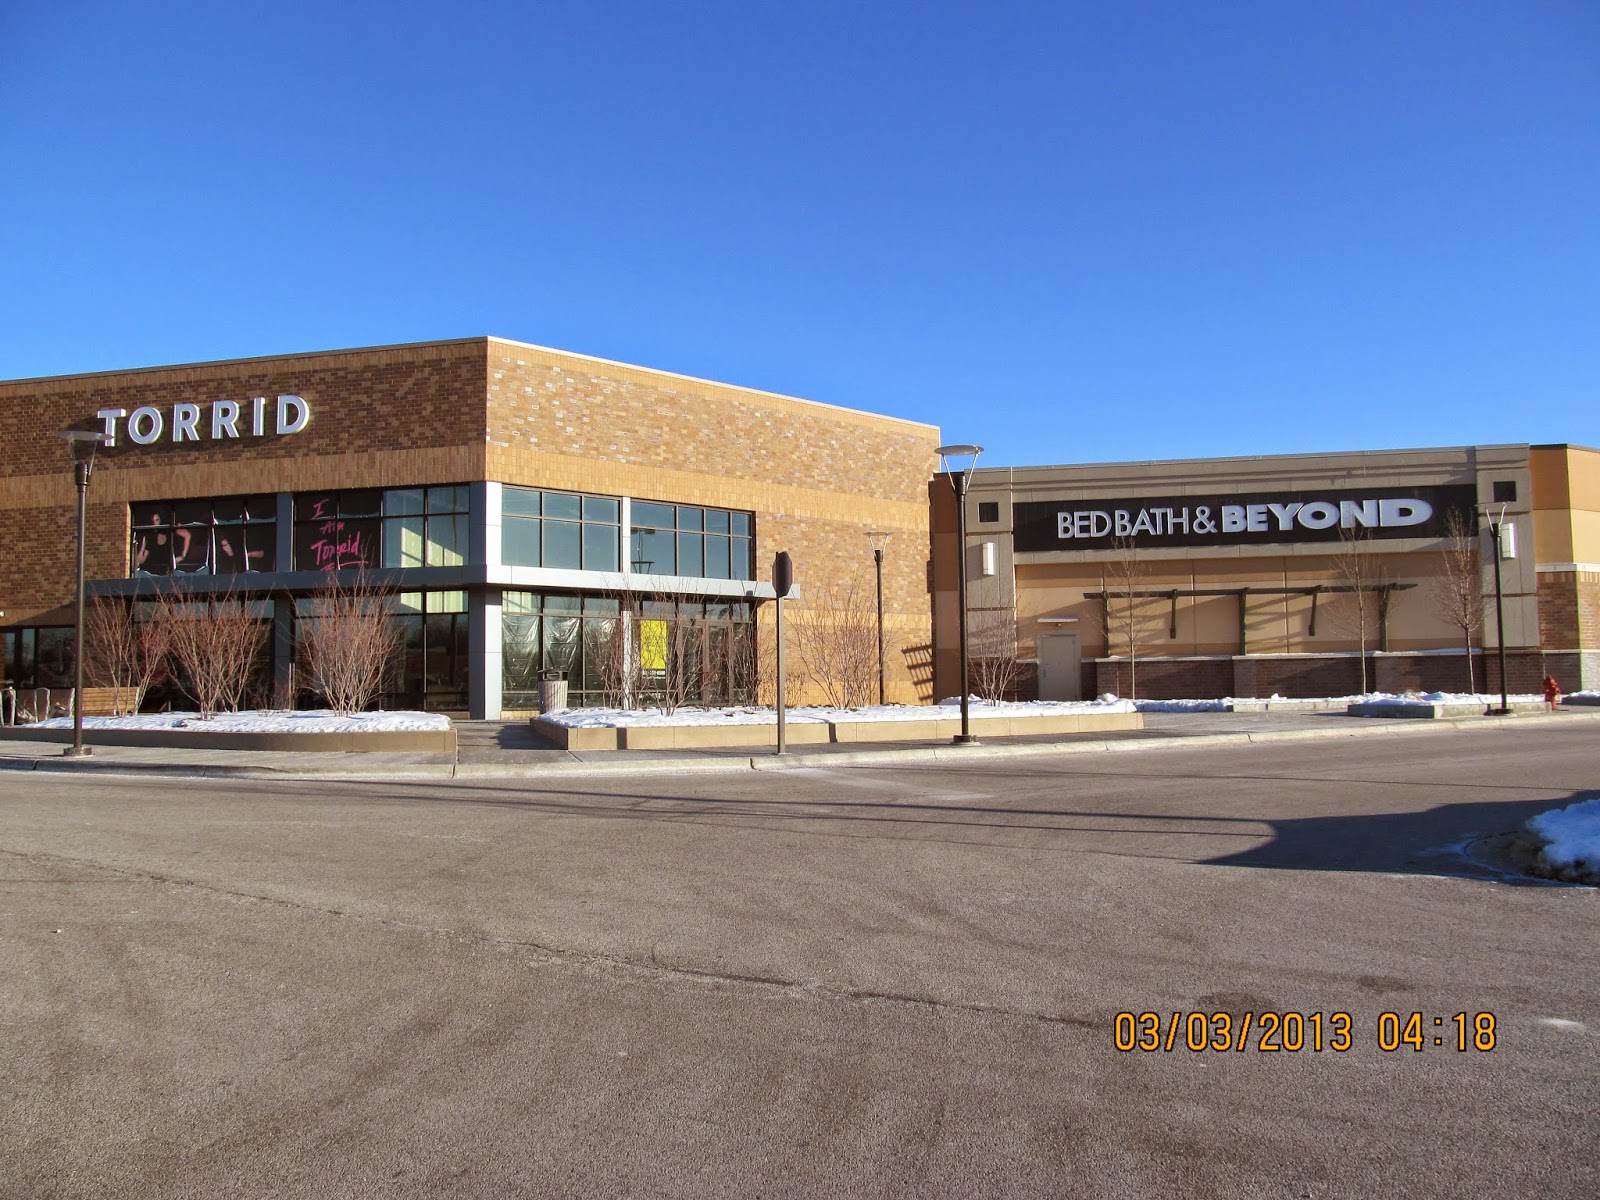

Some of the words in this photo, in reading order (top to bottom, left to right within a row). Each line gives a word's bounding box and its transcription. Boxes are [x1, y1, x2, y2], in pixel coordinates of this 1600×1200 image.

[97, 394, 310, 447] TORRID
[312, 499, 329, 519] I
[1058, 511, 1112, 538] BED
[1114, 507, 1189, 537] BATH
[1192, 506, 1218, 534] &
[1221, 499, 1433, 533] BEYOND
